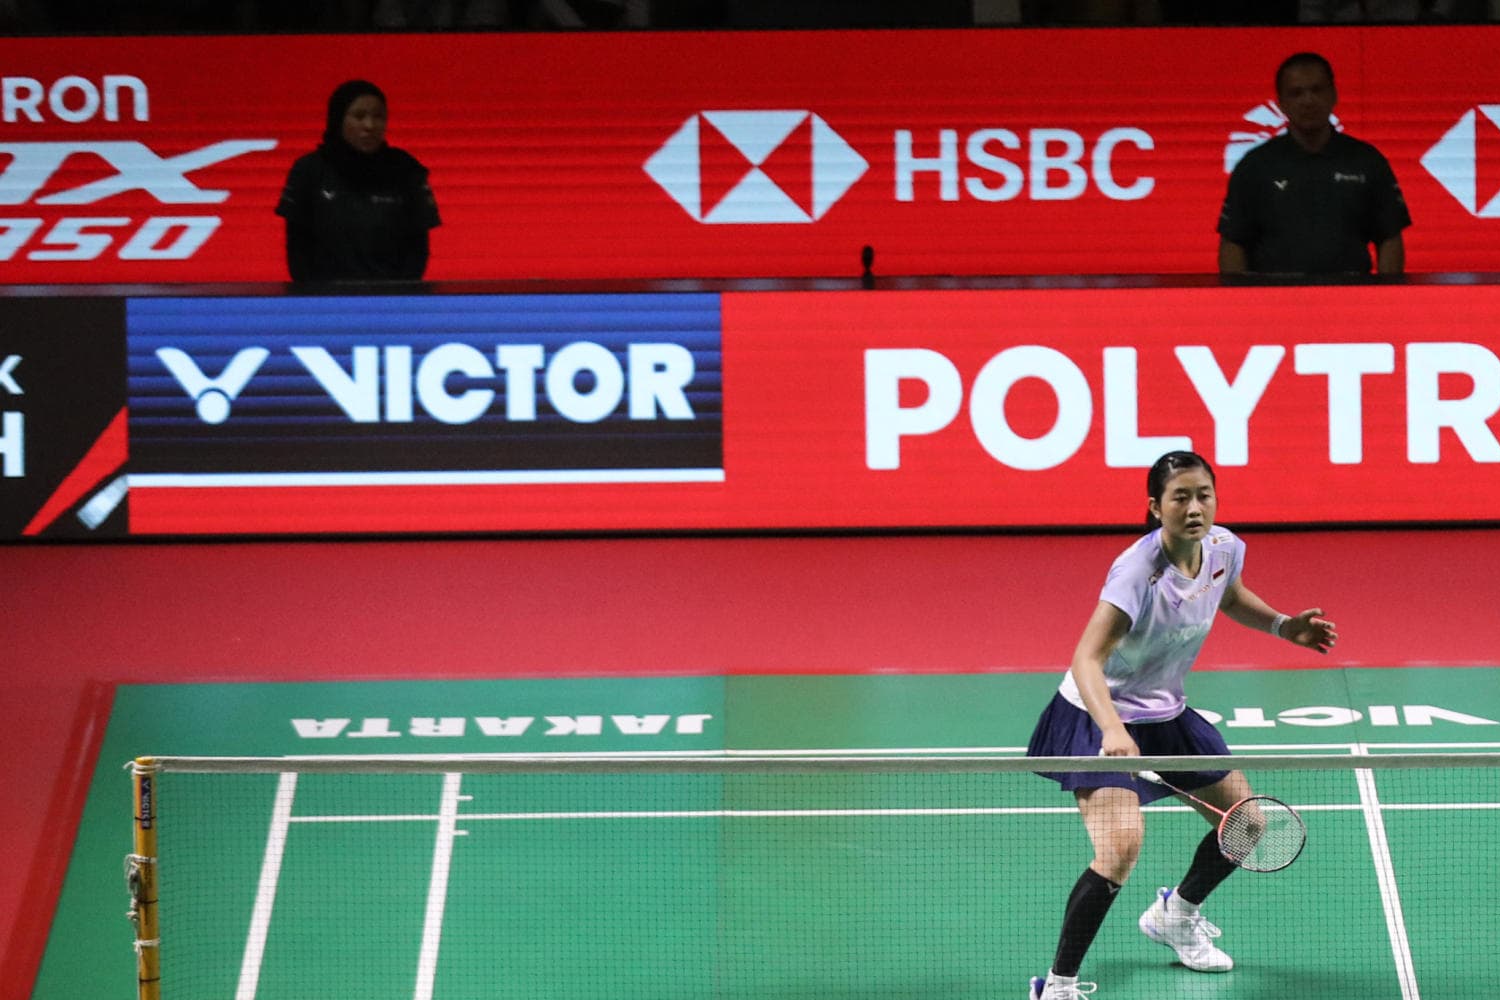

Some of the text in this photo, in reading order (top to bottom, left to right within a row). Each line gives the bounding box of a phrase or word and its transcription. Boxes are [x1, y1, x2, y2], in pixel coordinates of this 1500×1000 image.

[893, 127, 1156, 203] HSBC
[290, 340, 696, 424] VICTOR
[291, 714, 713, 739] JAKARTA
